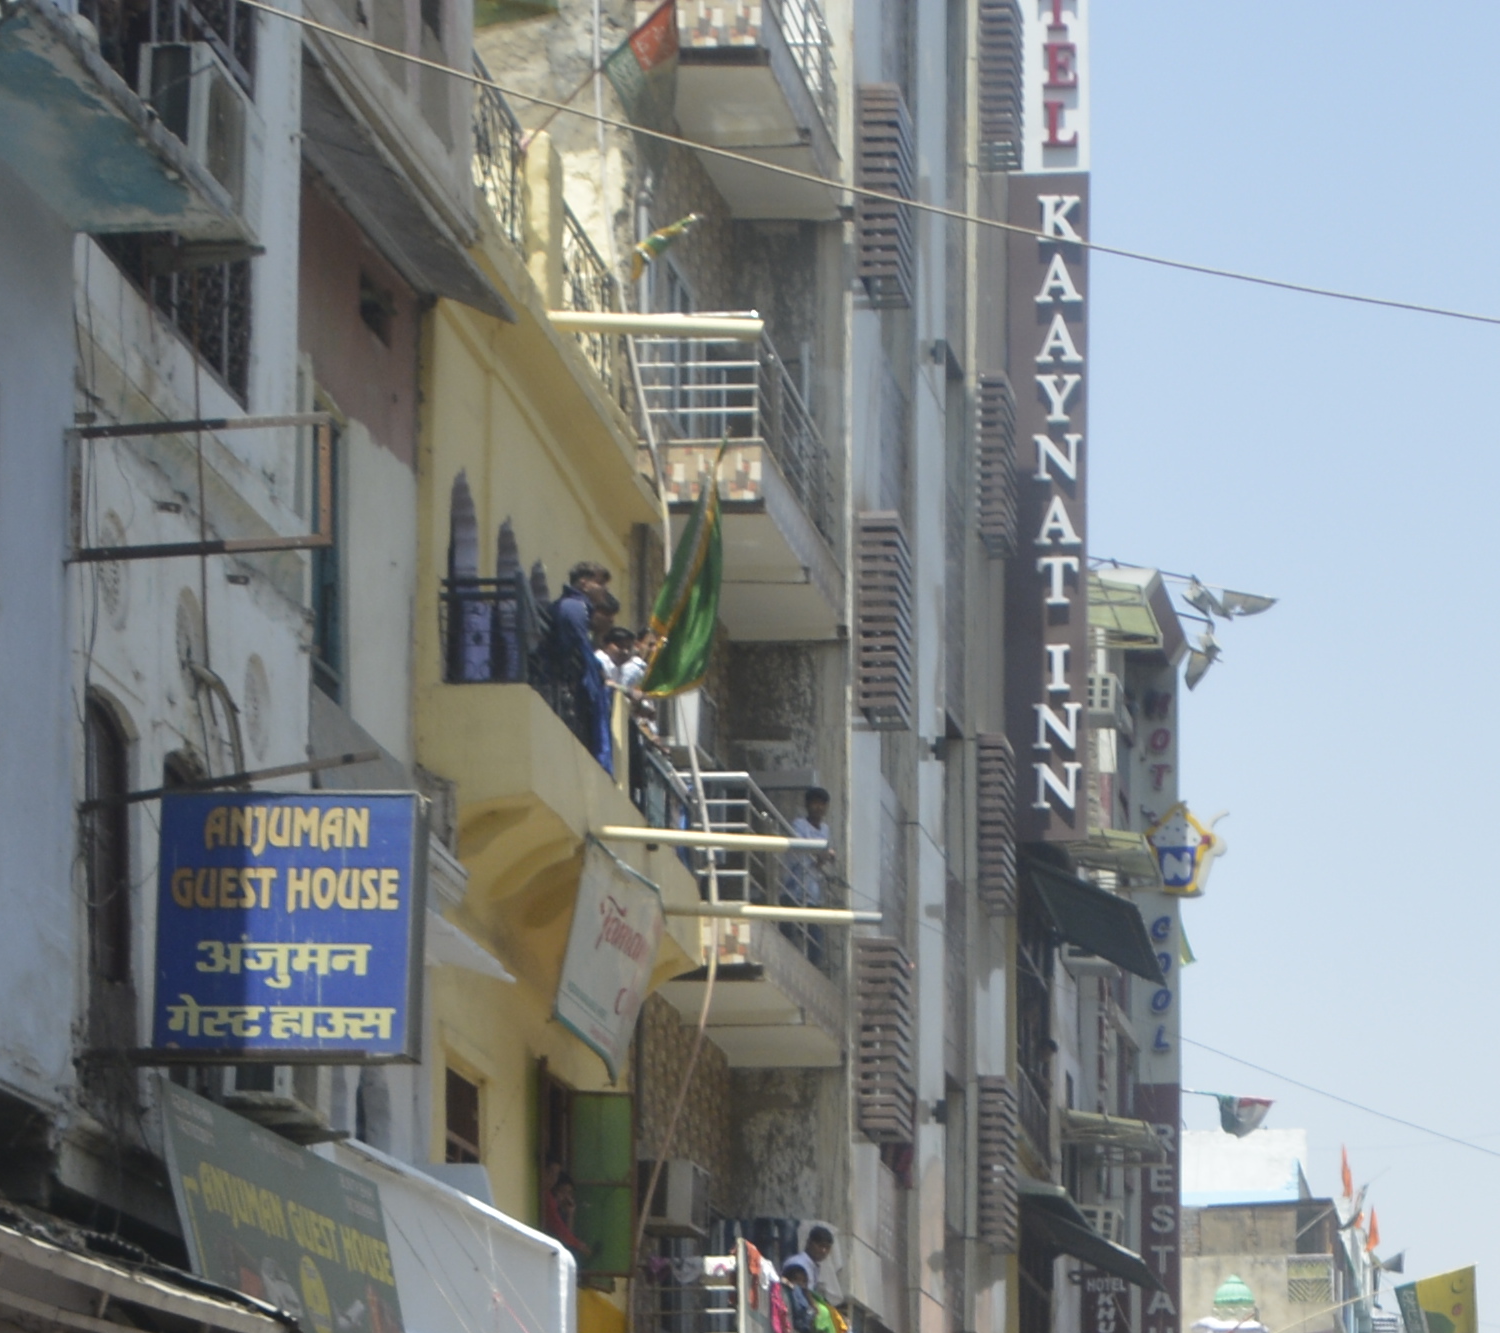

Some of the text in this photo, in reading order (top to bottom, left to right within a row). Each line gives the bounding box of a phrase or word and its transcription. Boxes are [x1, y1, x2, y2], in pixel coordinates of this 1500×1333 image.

[1033, 195, 1083, 809] KAAYNAT INN
[204, 806, 370, 856] ANJUMAN
[171, 867, 399, 912] GUEST HOUSE
[195, 934, 372, 988] अंजुमन
[166, 994, 266, 1037] गेस्ट
[198, 1160, 290, 1241] ANJUMAN
[287, 1199, 341, 1263] GUEST
[339, 1224, 395, 1288] HOUSE
[1086, 1278, 1127, 1292] HOTEL
